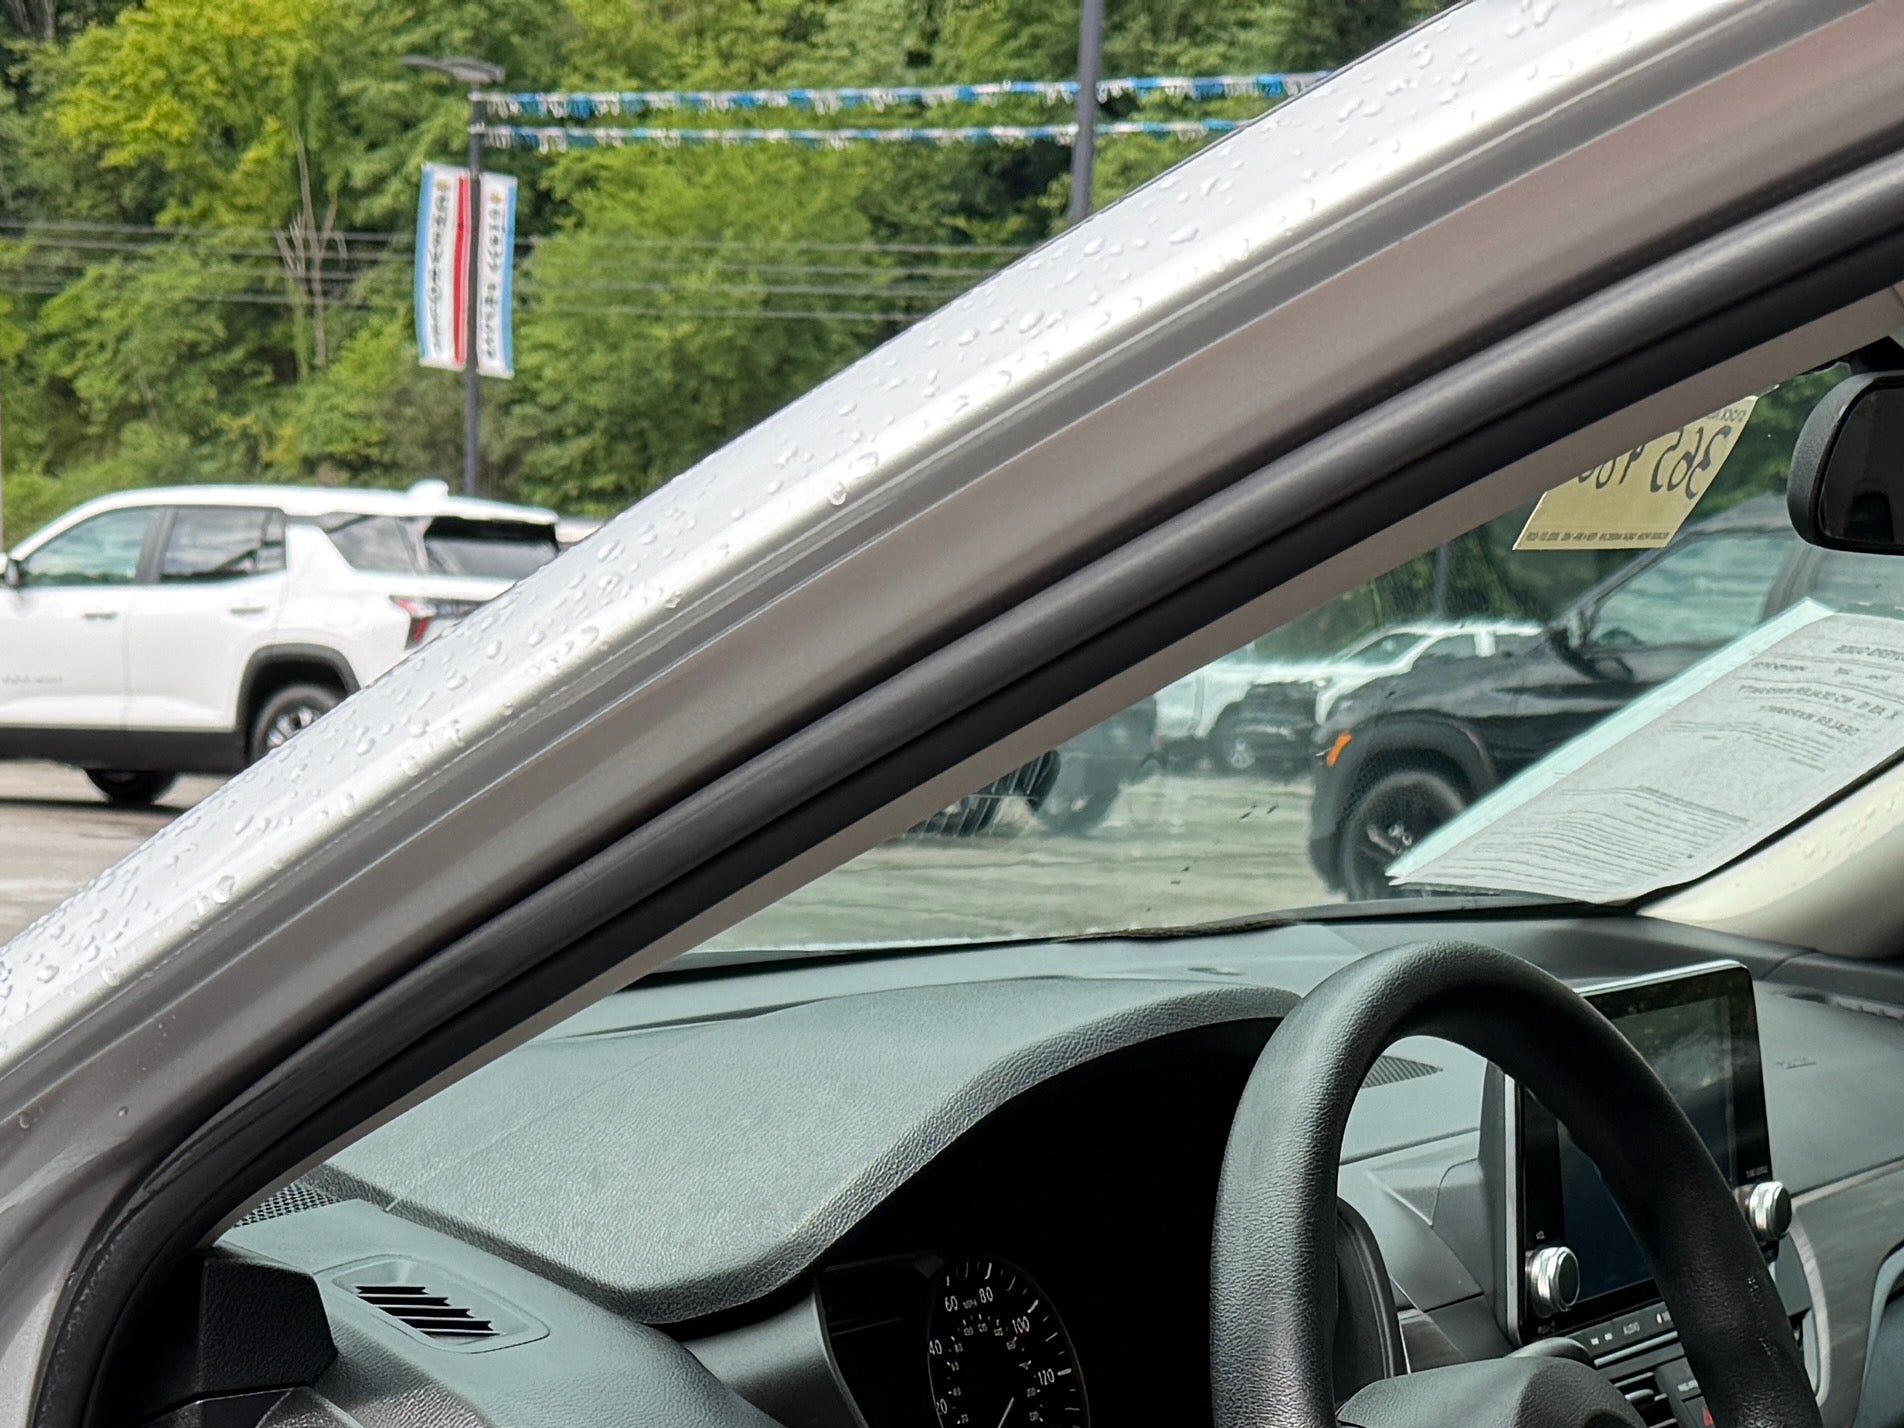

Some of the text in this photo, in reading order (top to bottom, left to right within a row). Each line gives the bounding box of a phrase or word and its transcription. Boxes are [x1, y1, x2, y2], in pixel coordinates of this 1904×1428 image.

[979, 1286, 993, 1303] 80
[945, 1296, 958, 1311] 60
[1012, 1316, 1030, 1333] 100
[929, 1339, 942, 1355] 40
[1038, 1368, 1055, 1385] 120
